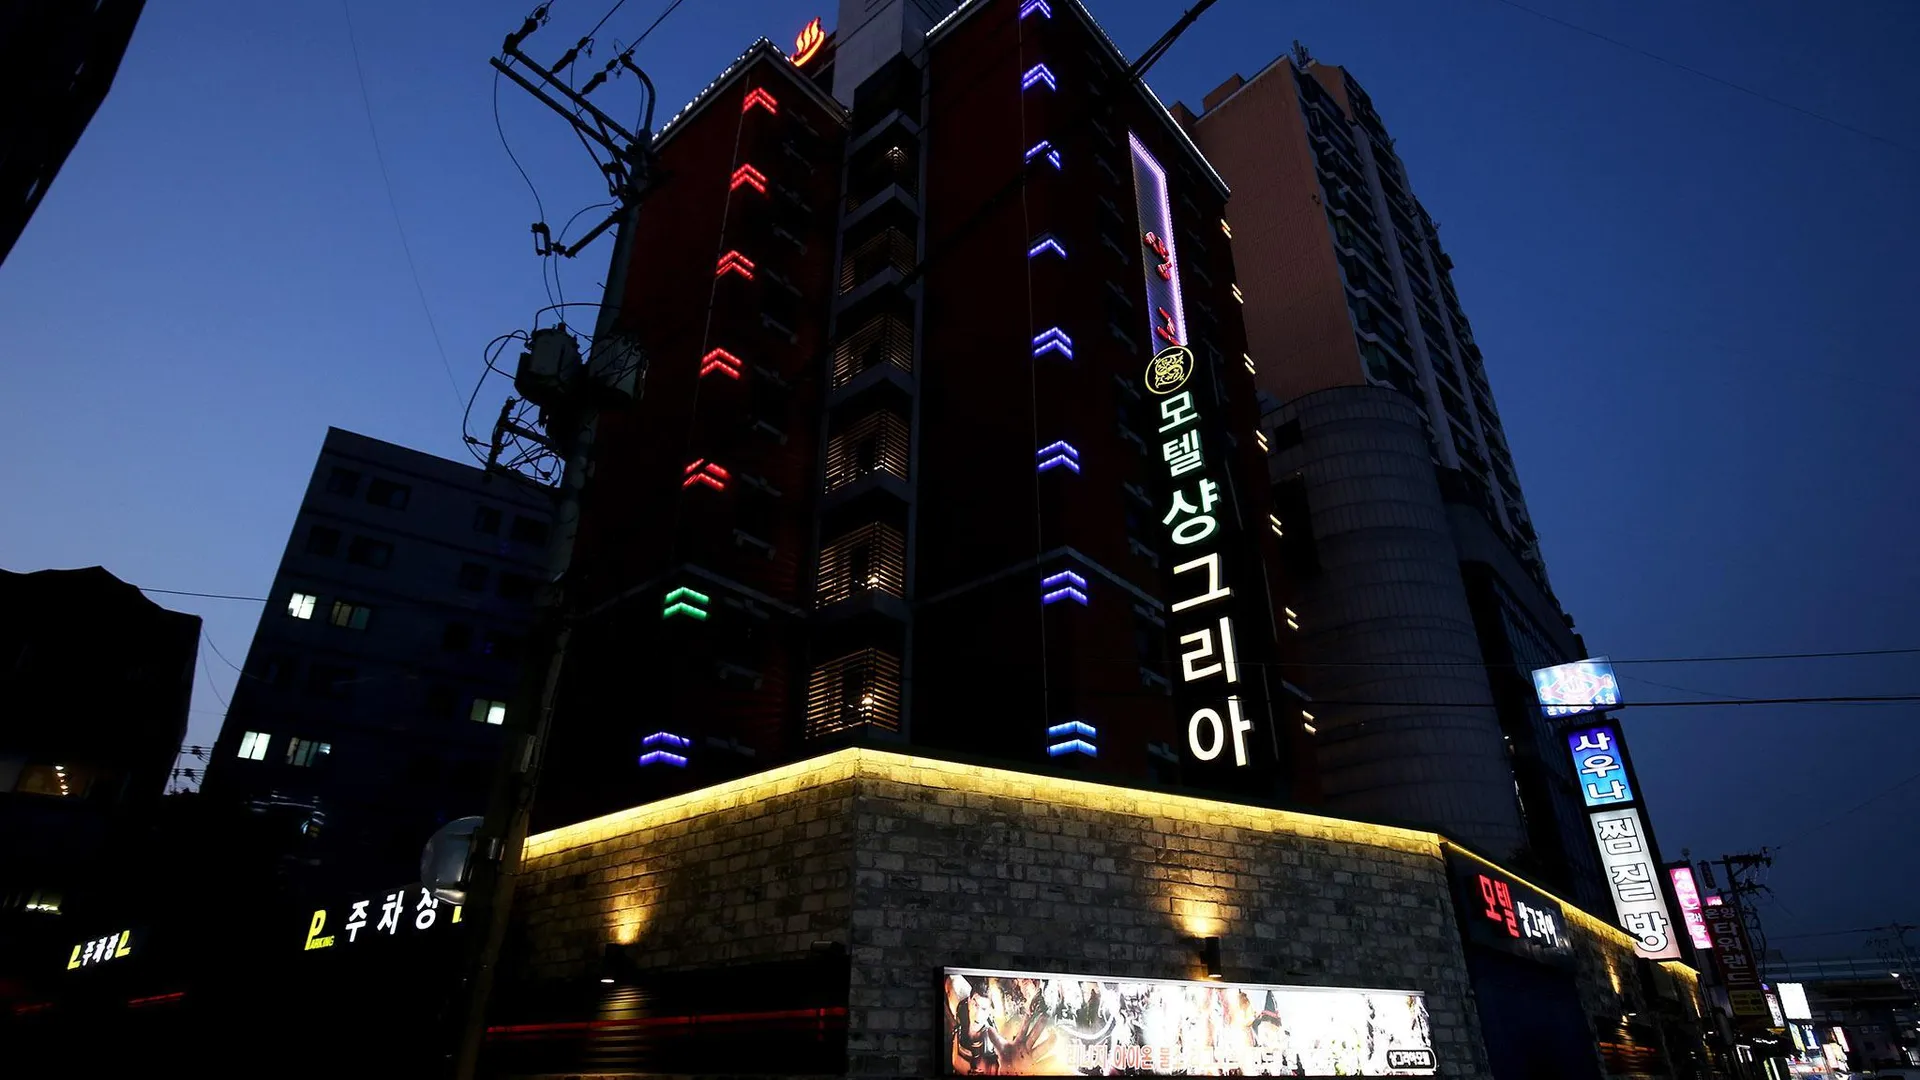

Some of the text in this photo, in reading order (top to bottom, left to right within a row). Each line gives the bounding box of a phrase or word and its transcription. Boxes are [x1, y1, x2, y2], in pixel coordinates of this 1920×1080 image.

[1158, 390, 1203, 477] 모텔
[1162, 478, 1252, 768] 샹그리아
[1574, 731, 1626, 801] 사우나
[1479, 875, 1520, 938] 모텔
[1598, 816, 1670, 952] 찜질방
[1713, 921, 1756, 986] 타워랜드
[1114, 1044, 1154, 1069] 아이온
